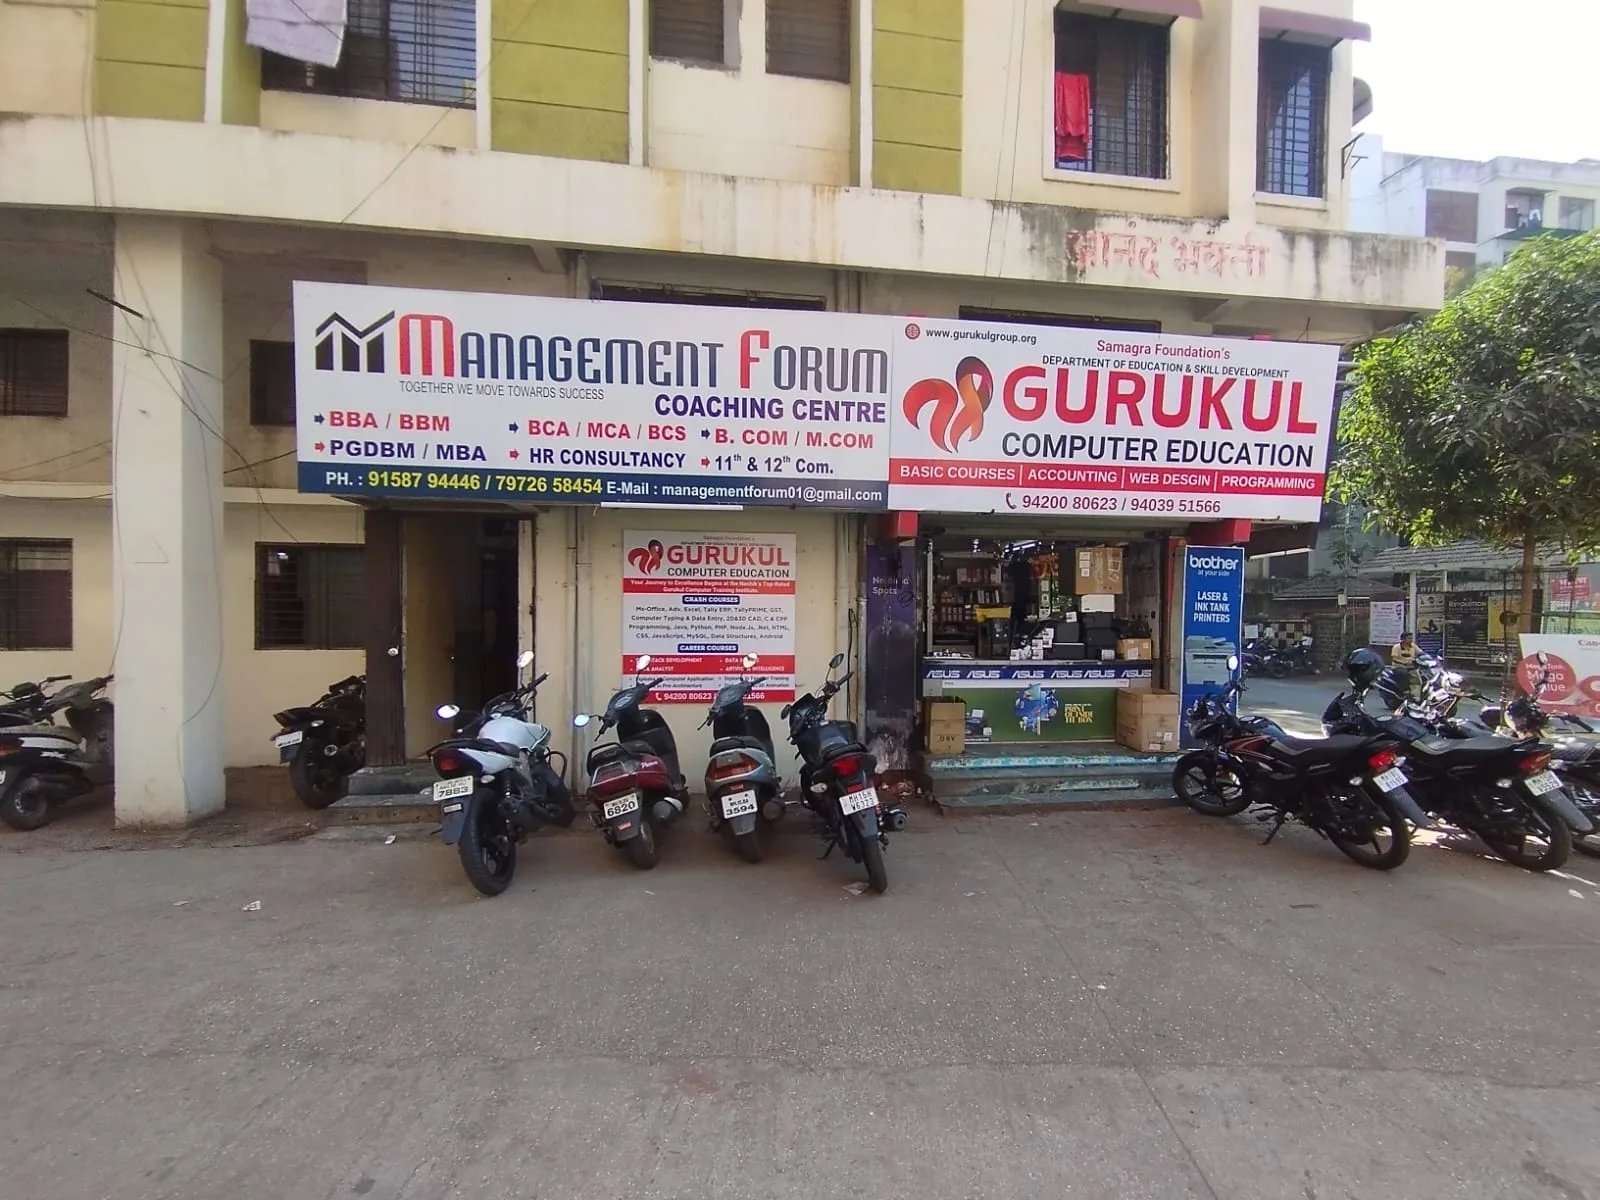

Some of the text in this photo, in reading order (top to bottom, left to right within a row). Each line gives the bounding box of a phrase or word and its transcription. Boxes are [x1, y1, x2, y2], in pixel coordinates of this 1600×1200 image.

[926, 328, 1037, 345] www.gurukulgroup.org
[1097, 340, 1231, 360] Samagra Foundation's
[1042, 356, 1290, 379] DEPARTMENT OF EDUCATION & SKILL DEVELOPMENT
[400, 380, 604, 400] TOGETHER WE MOVE TOWARDS SUCCESS
[1003, 365, 1318, 434] GURUKUL
[655, 394, 886, 423] COACHING CENTRE
[329, 411, 450, 432] BBA / BBM
[528, 420, 686, 441] BCA / MCA / BCS
[715, 428, 874, 448] B. COM / M.COM
[330, 440, 487, 462] PGDBM / MBA
[530, 448, 686, 469] HR CONSULTANCY
[1002, 432, 1314, 468] COMPUTER EDUCATION
[715, 454, 834, 475] 11th & 12th Com.
[900, 465, 1016, 480] BASIC COURSES
[326, 472, 353, 486] PH.
[368, 471, 421, 488] 91587
[427, 473, 480, 490] 94446
[484, 474, 490, 491] /
[496, 475, 548, 492] 79726
[552, 476, 603, 493] 58454
[1028, 468, 1118, 482] ACCOUNTING
[1130, 472, 1211, 486] WEB DESGIN
[1222, 476, 1316, 490] PROGRAMMING
[607, 481, 649, 496] E-Mail
[662, 483, 882, 502] managementforum01@gmail.com
[1022, 495, 1221, 513] 94200 80623 / 94039 51566
[667, 545, 790, 567] GURUKUL
[1190, 554, 1239, 570] brother
[668, 567, 790, 578] COMPUTER EDUCATION
[873, 586, 897, 596] Spots
[1197, 591, 1228, 601] LASER &
[1195, 602, 1230, 612] INK TANK
[1194, 613, 1230, 623] PRINTERS
[926, 670, 1152, 678] ASUS ASUS ASUS ASUS ASUS ASUS
[607, 801, 635, 816] 6820
[726, 804, 754, 815] 3594
